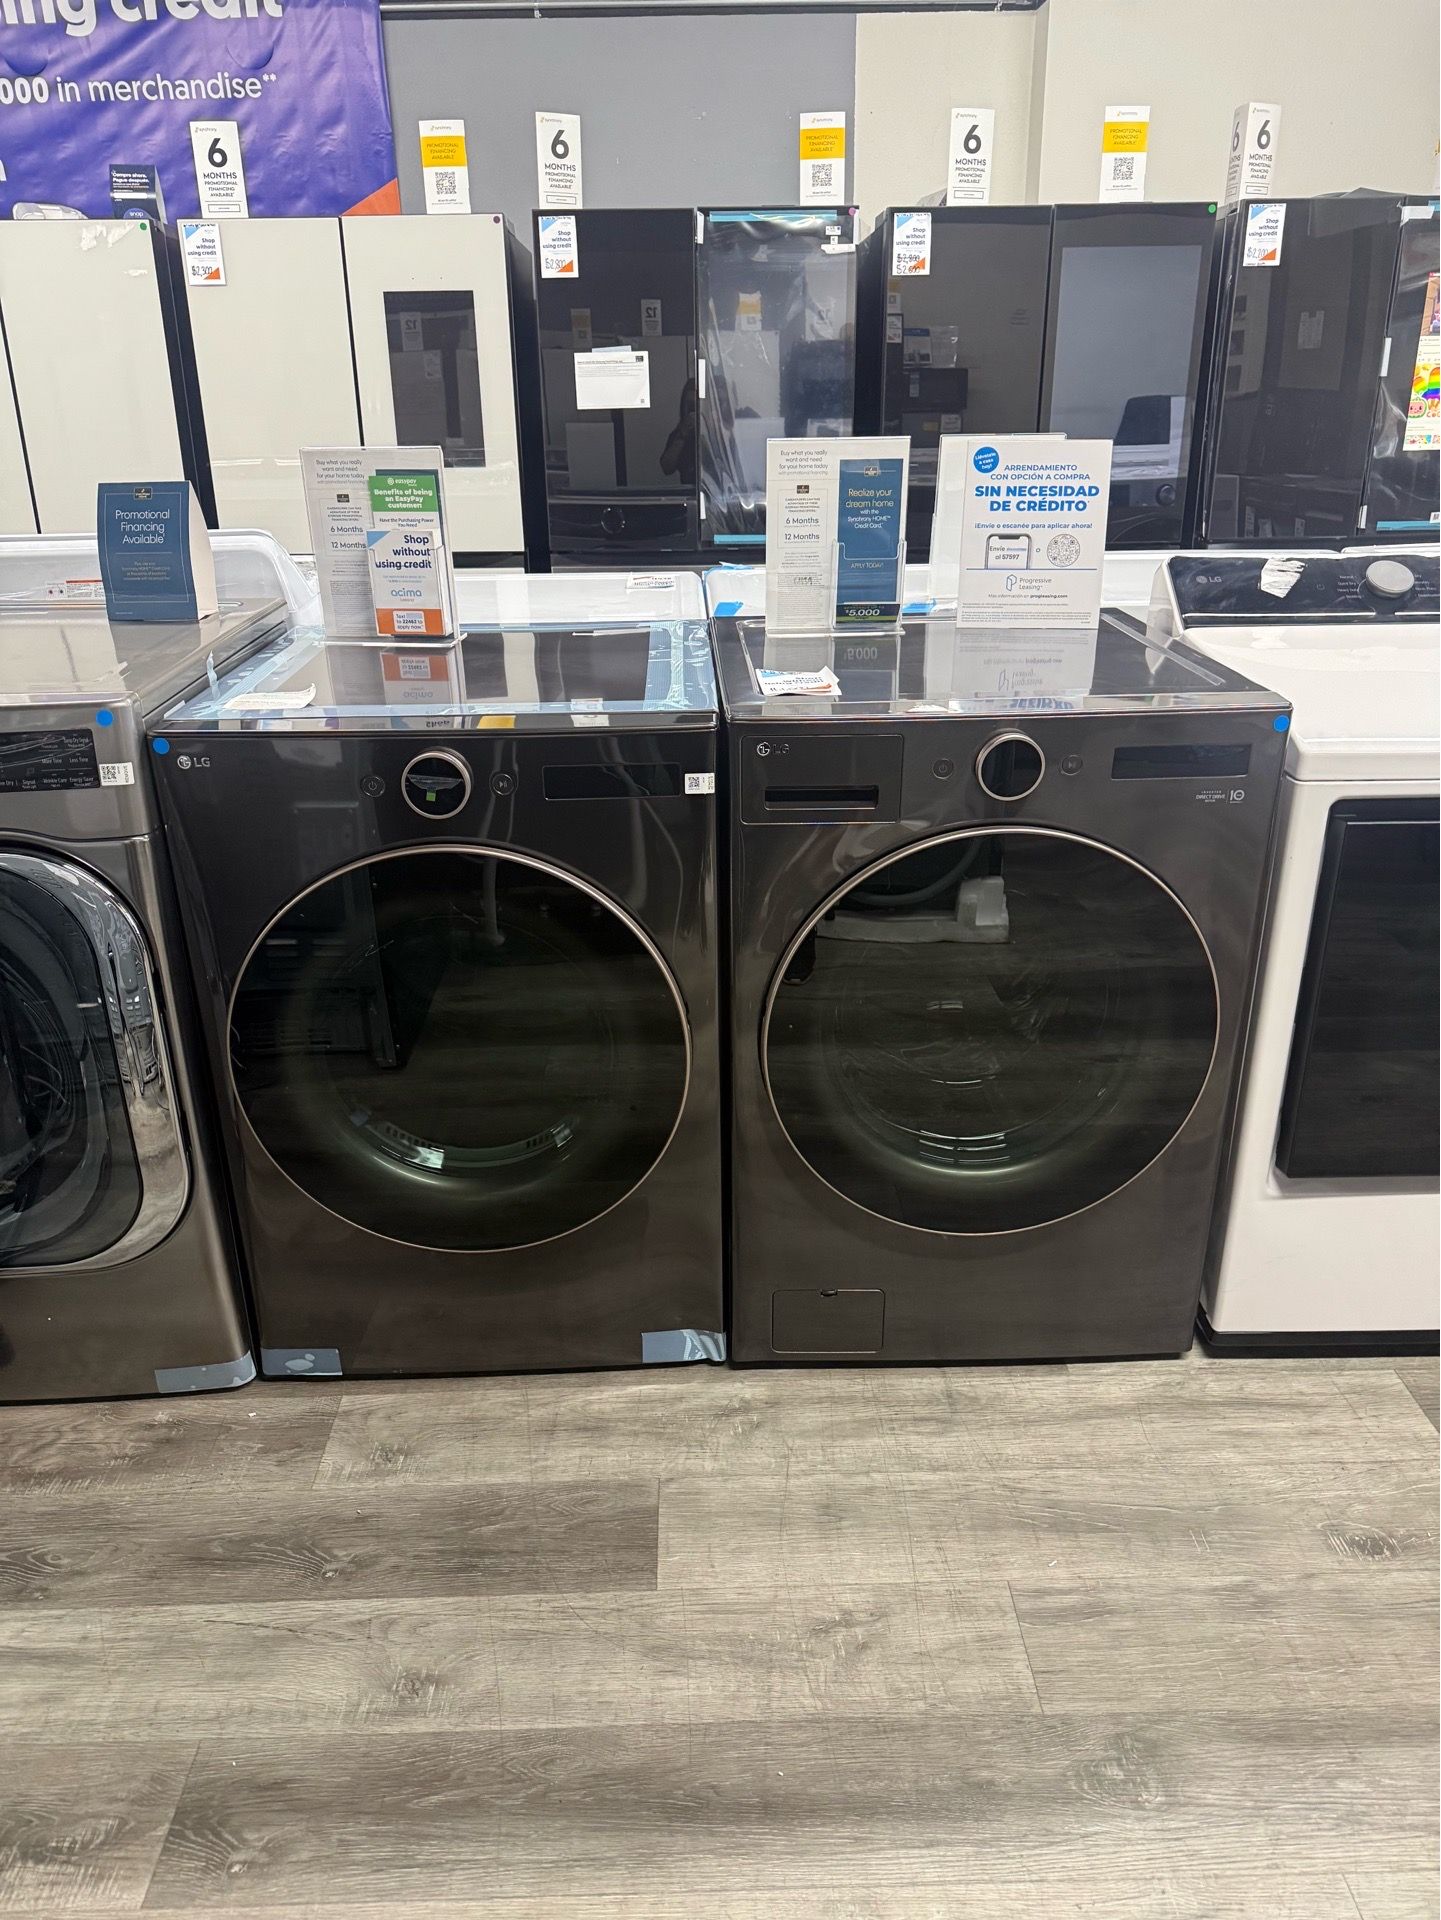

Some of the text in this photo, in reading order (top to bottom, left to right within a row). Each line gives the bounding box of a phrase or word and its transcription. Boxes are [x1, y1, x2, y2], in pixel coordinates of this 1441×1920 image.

[56, 77, 81, 102] in
[964, 124, 982, 154] 6
[1256, 120, 1271, 150] 6
[550, 130, 570, 160] 6
[208, 138, 228, 168] 6
[1248, 154, 1273, 162] MONTHS
[544, 163, 576, 172] MONTHS
[413, 488, 432, 496] being
[848, 488, 892, 498] Realize your
[975, 486, 1100, 497] SIN NECESIDAD
[846, 499, 894, 508] dream home
[990, 500, 1011, 512] DE
[116, 509, 170, 520] Promotional
[120, 522, 165, 534] Financing
[404, 534, 430, 546] Shop
[392, 546, 431, 556] without
[376, 558, 402, 570] using
[404, 560, 432, 568] credit
[390, 588, 422, 596] acima
[194, 757, 210, 768] LG
